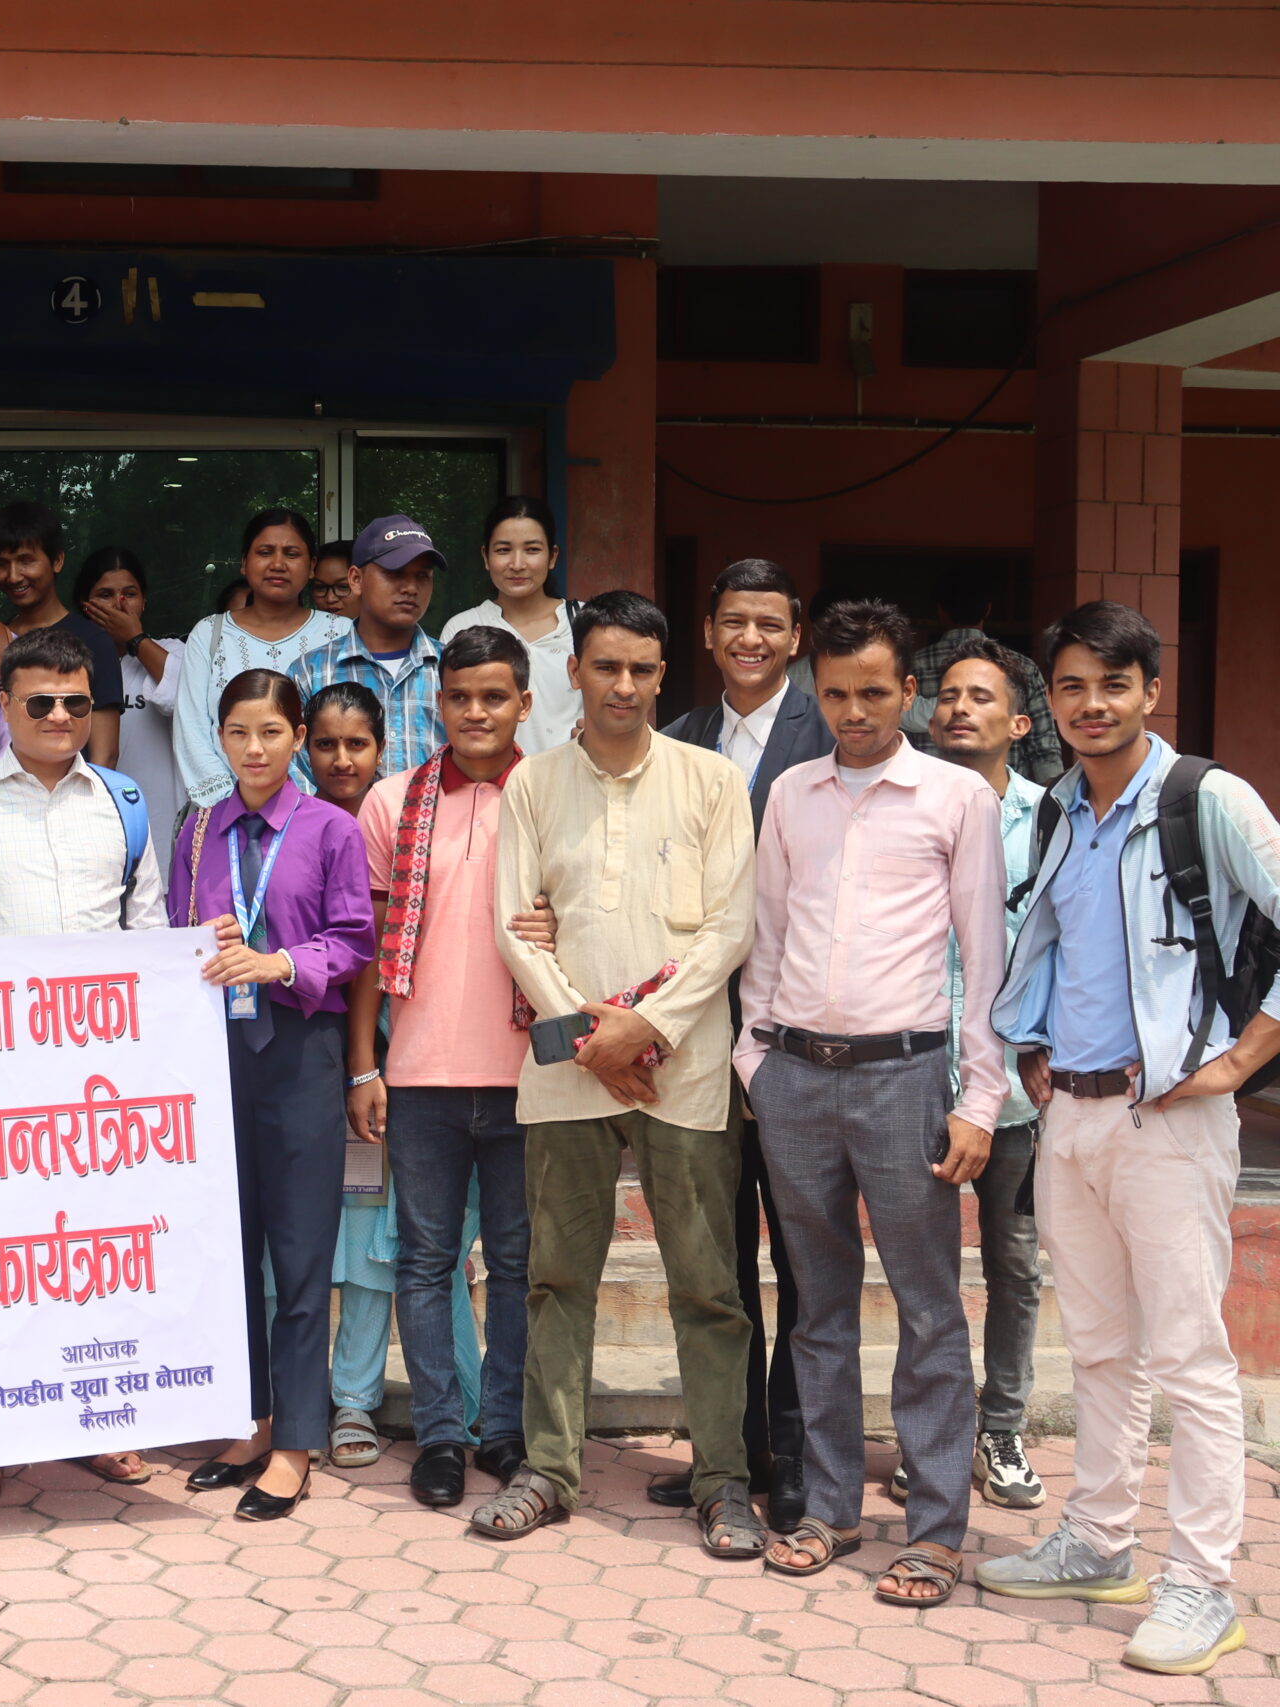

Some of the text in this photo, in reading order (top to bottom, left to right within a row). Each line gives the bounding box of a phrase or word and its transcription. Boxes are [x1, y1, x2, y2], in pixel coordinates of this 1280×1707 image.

[61, 282, 89, 317] 4
[27, 972, 140, 1048] भएका
[61, 1337, 139, 1364] आयोजक
[70, 1377, 109, 1404] युवा
[115, 1370, 150, 1395] संघ
[156, 1364, 215, 1389] नेपाल
[78, 1402, 138, 1431] कैलाली
